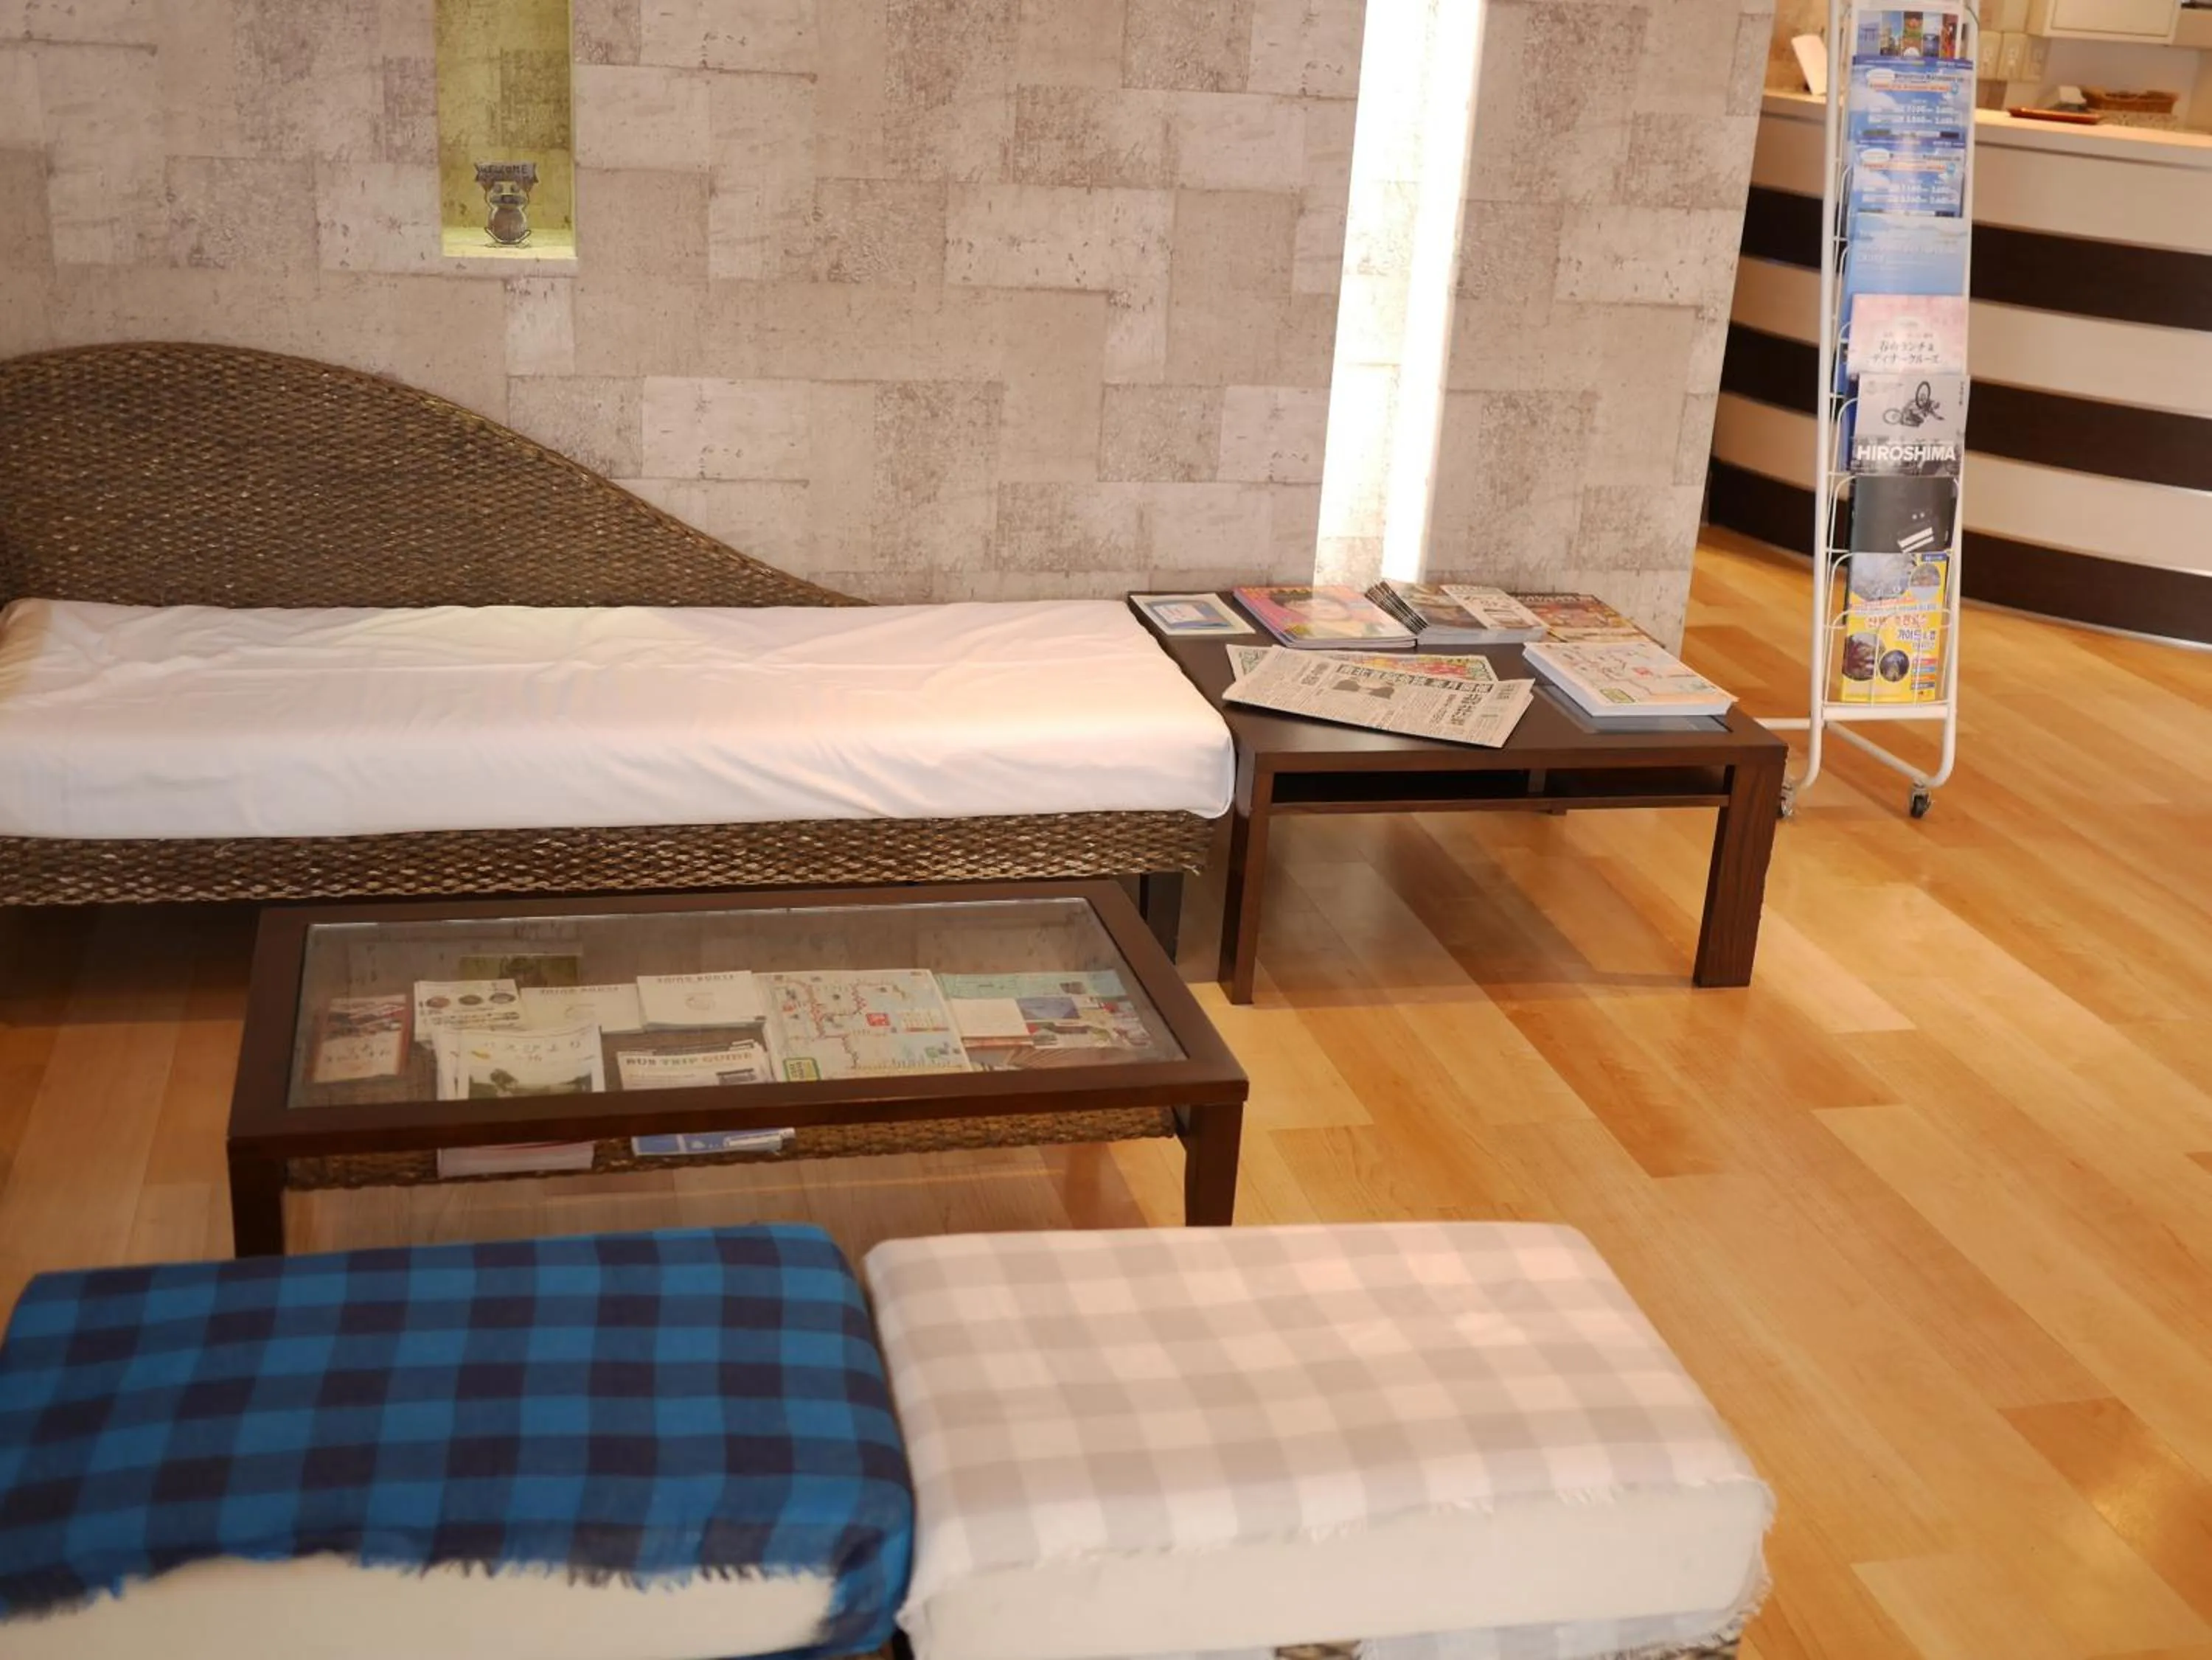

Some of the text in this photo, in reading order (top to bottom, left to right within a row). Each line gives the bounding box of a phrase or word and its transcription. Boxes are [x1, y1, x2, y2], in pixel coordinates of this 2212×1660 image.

[479, 164, 528, 175] WELCOME
[1857, 444, 1955, 461] HIROSHIMA
[660, 1056, 698, 1066] TRIP
